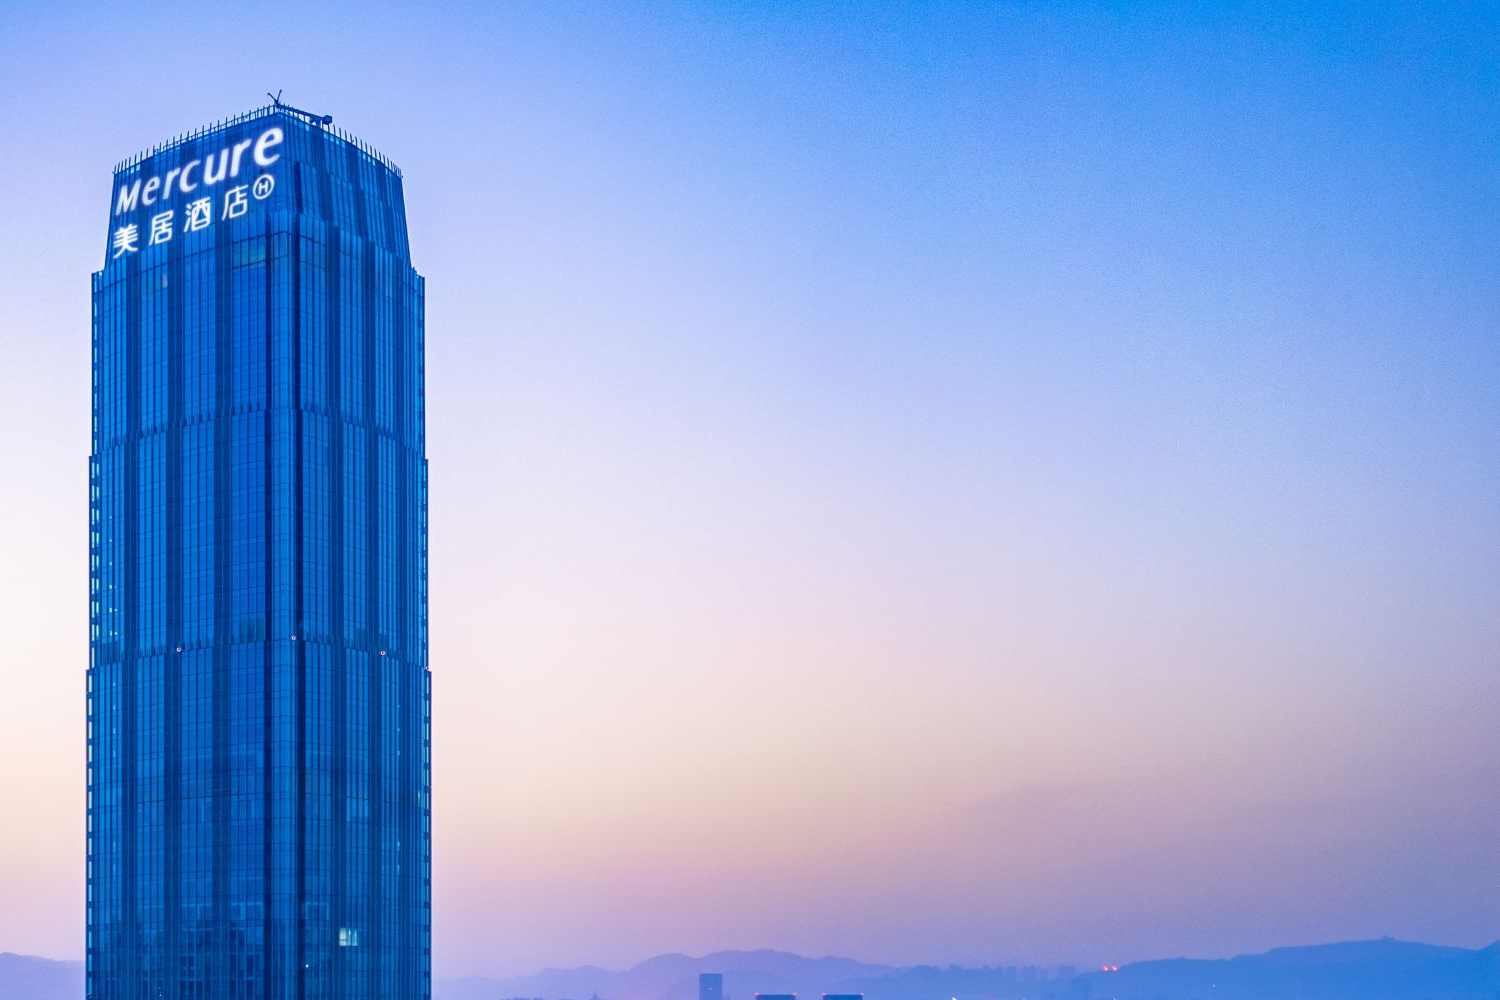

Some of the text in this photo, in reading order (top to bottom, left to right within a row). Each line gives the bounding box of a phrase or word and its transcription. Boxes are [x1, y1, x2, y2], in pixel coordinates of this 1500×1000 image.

[116, 127, 283, 215] Mercure
[113, 184, 248, 258] 美居酒店
